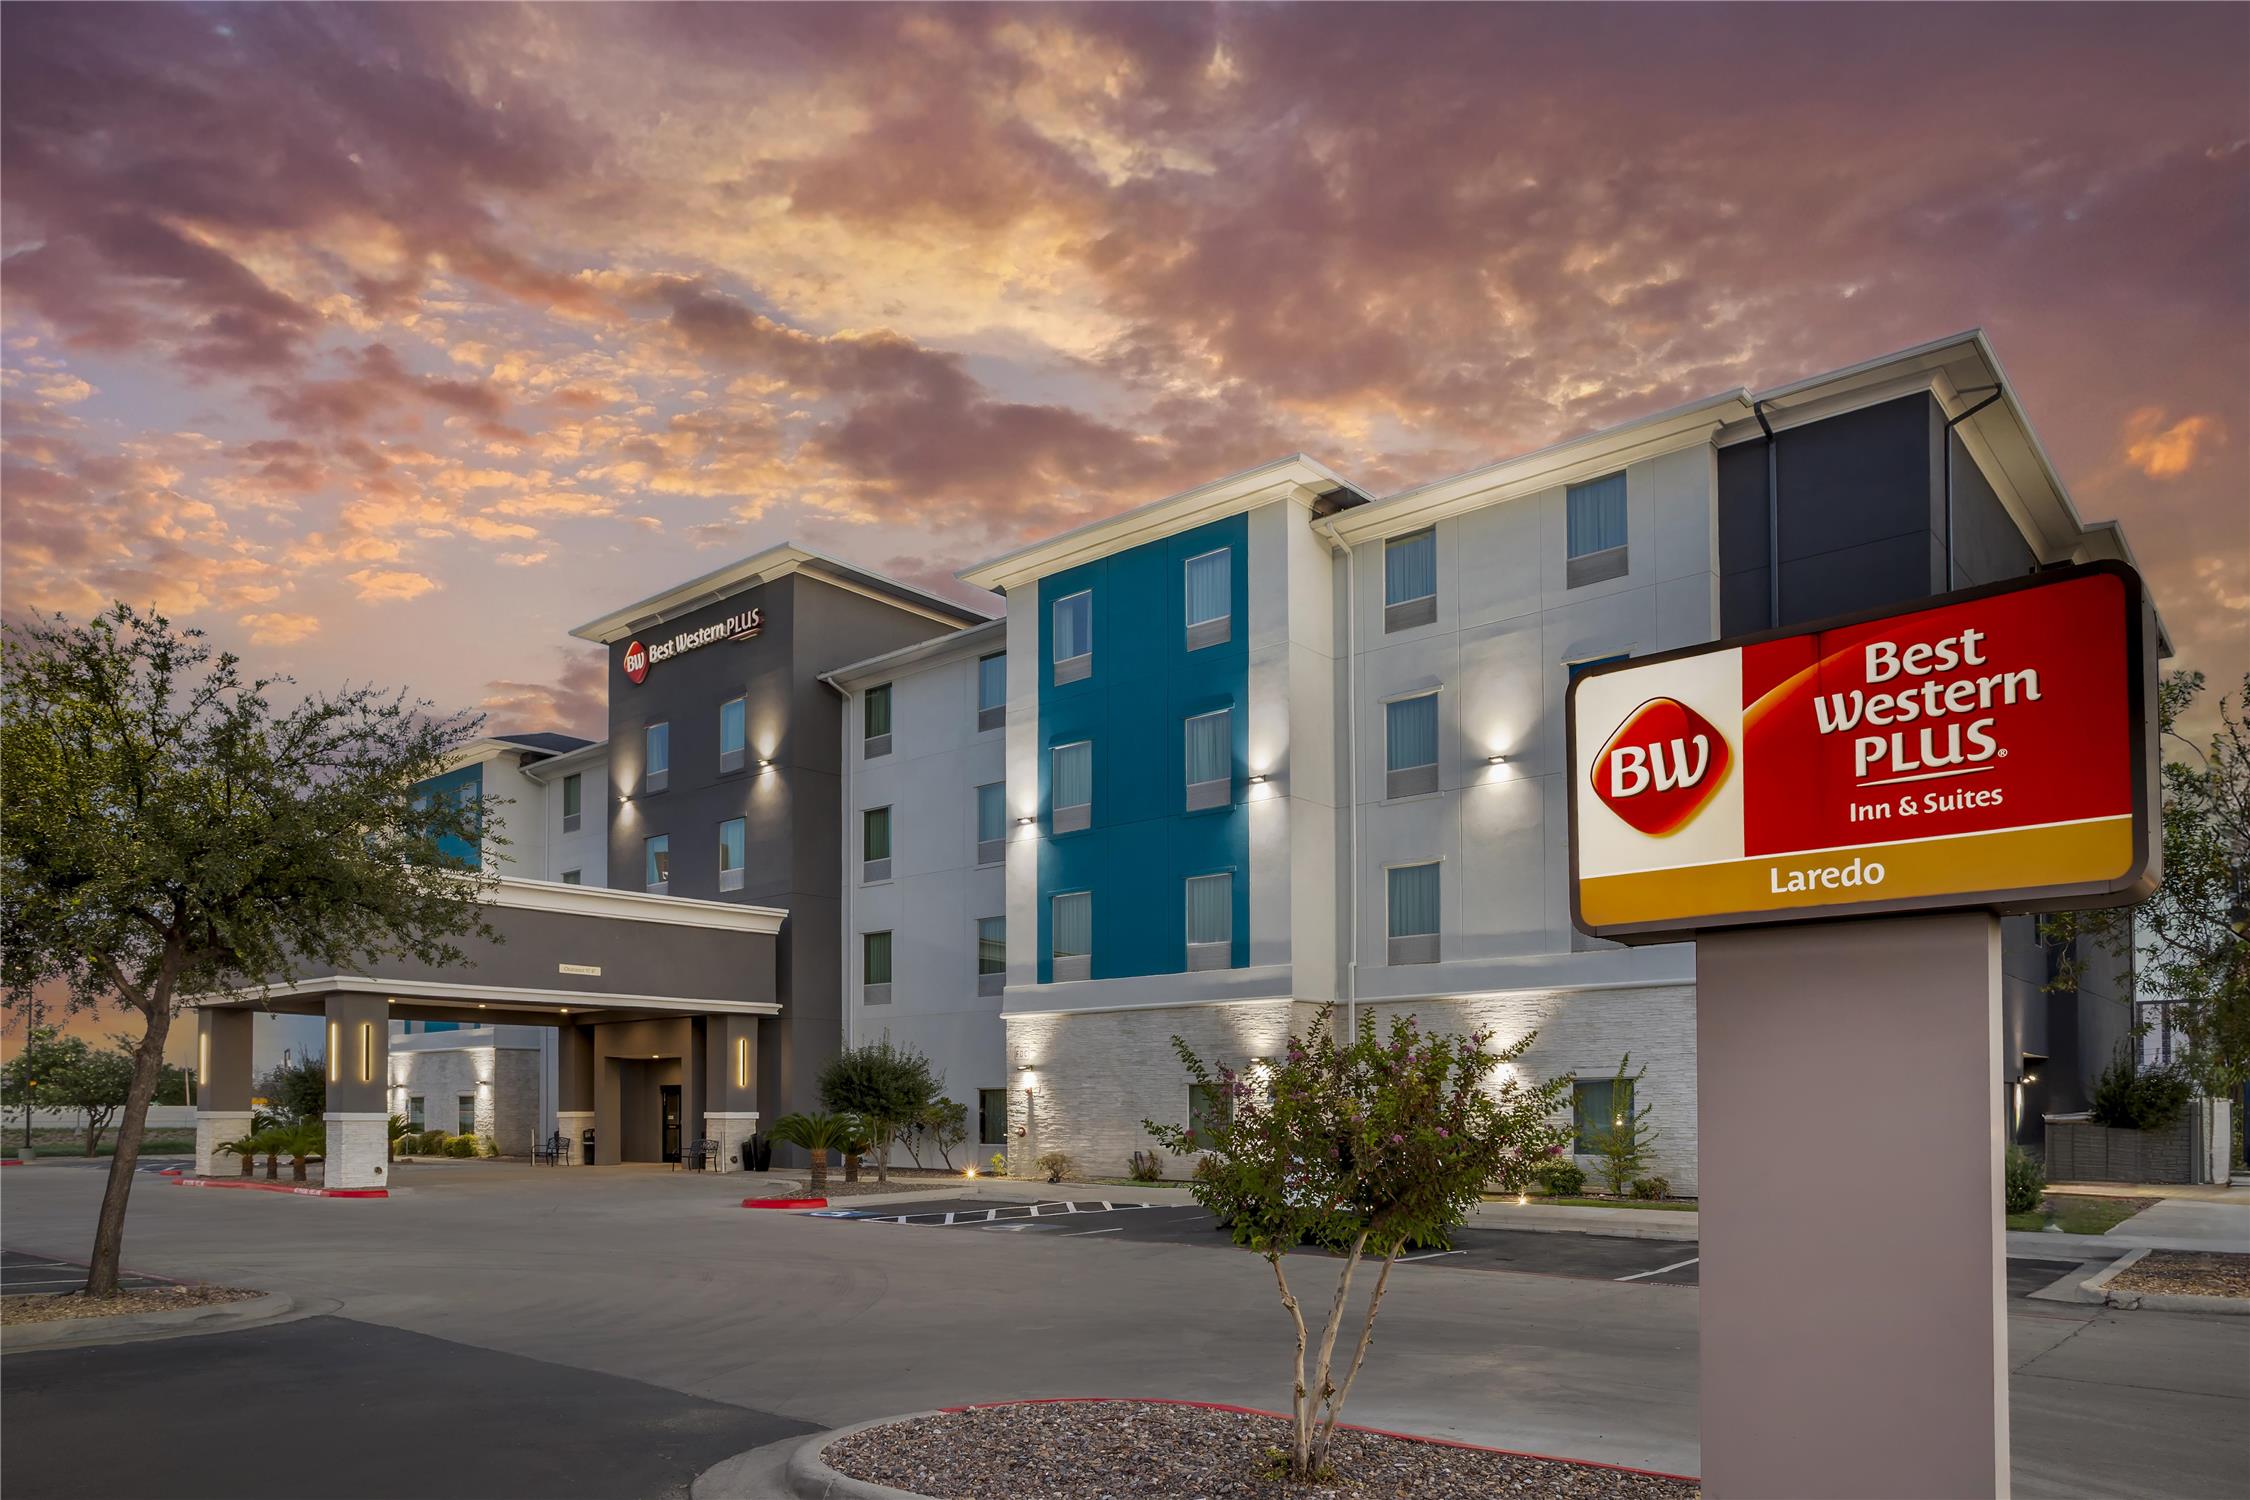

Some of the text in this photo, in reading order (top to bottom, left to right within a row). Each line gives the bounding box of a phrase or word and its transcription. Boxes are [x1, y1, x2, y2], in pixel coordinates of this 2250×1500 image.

[626, 652, 645, 673] BW
[649, 608, 760, 663] Best Western PLUS
[1865, 628, 1987, 684] Best
[1813, 667, 2042, 735] Western
[1610, 734, 1710, 798] BW
[1850, 788, 2004, 823] Inn & Suites
[1770, 857, 1886, 895] Laredo
